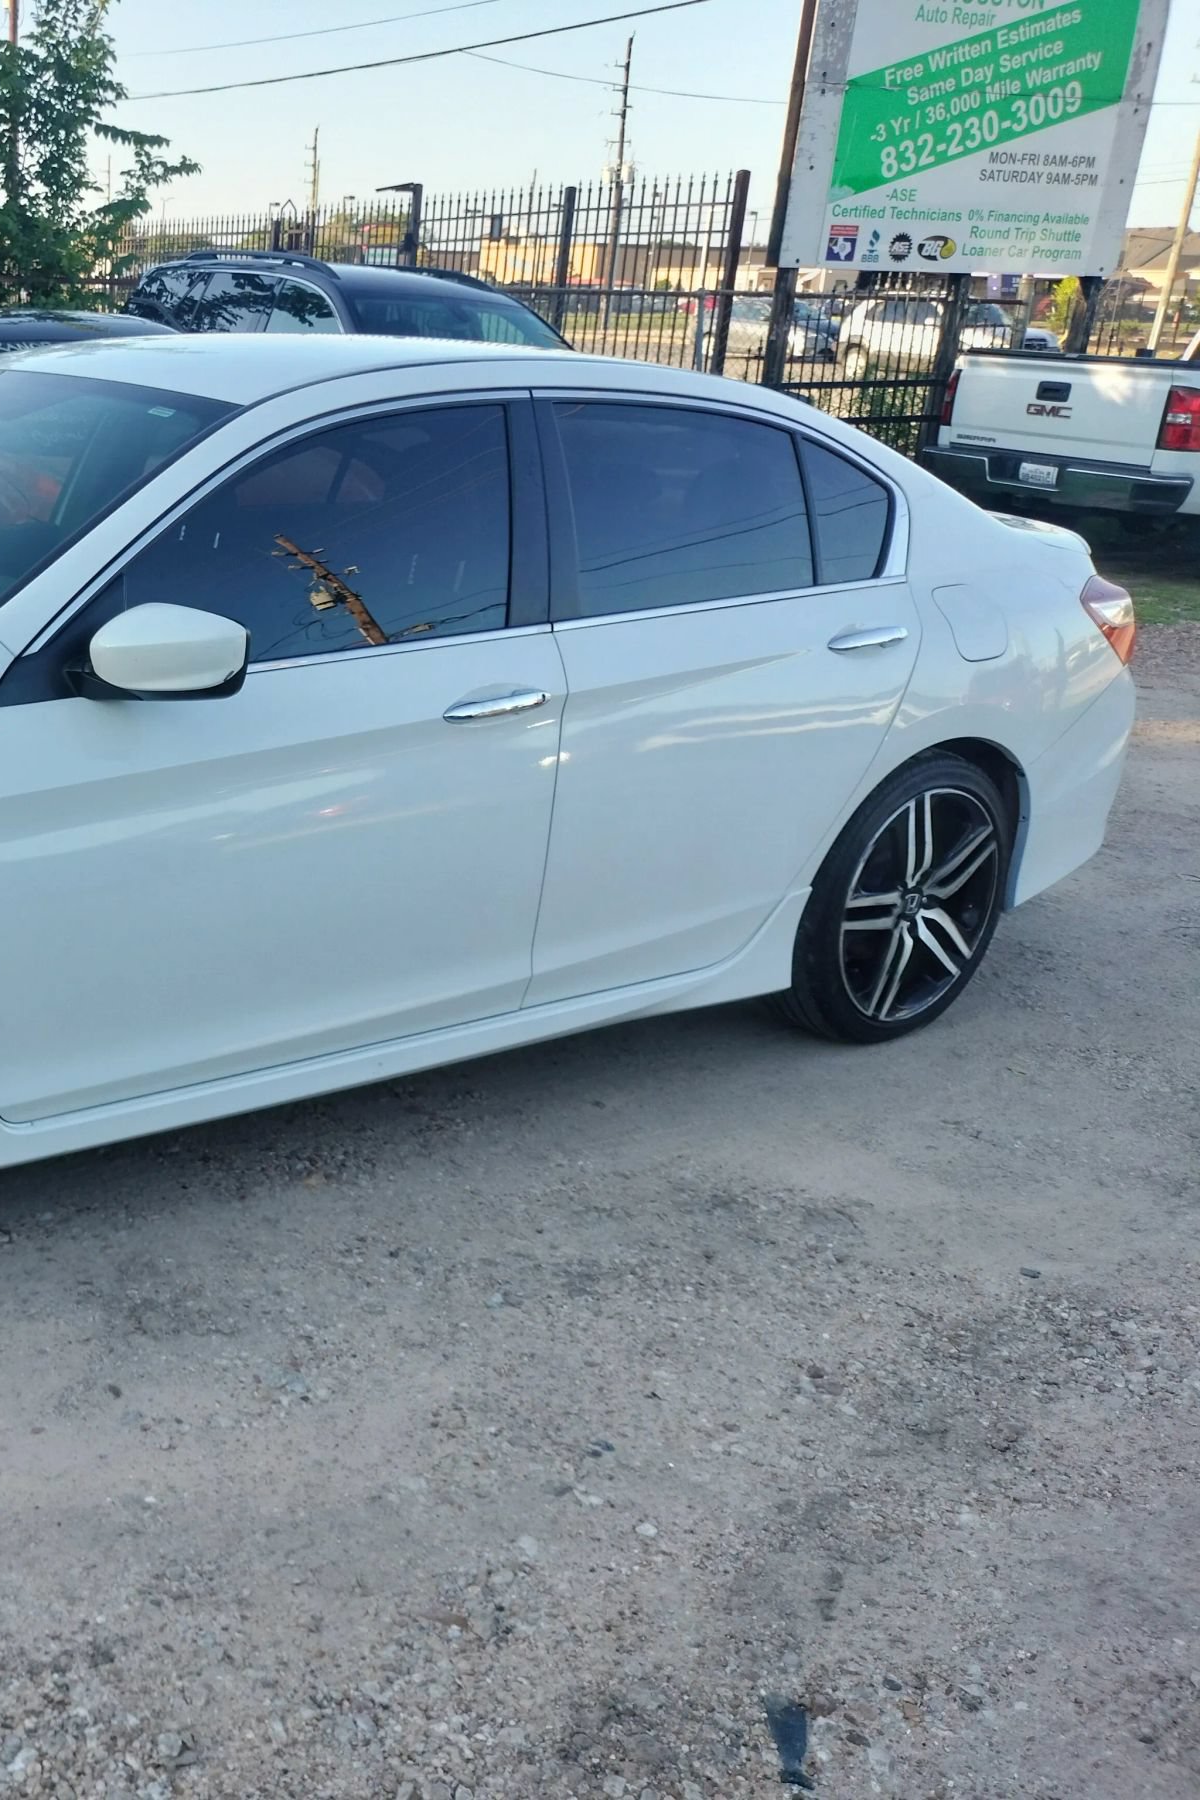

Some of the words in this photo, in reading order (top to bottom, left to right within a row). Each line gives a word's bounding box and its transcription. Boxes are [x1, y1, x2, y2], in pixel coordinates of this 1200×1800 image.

[915, 4, 948, 24] Auto
[952, 7, 997, 29] Repair
[884, 63, 924, 88] Free
[928, 38, 992, 73] Written
[997, 8, 1082, 49] Estimates
[907, 77, 956, 105] Same
[961, 63, 994, 87] Day
[1000, 40, 1064, 74] Service
[890, 117, 911, 136] Yr
[925, 90, 981, 124] 36,000
[985, 79, 1021, 104] Mile
[1026, 51, 1103, 89] Warranty
[880, 81, 1083, 179] 832-230-3009
[988, 151, 1041, 166] MON-FRI
[1042, 154, 1096, 169] 8AM-6PM
[979, 169, 1044, 184] SATURDAY
[1045, 172, 1099, 186] 9AM-5PM
[886, 188, 917, 202] -ASE
[832, 204, 886, 219] Certified
[890, 206, 962, 222] Technicians
[968, 209, 984, 221] 0%
[987, 210, 1040, 226] Financing
[1042, 212, 1090, 225] Available
[969, 226, 1010, 240] Round
[1014, 227, 1037, 243] Trip
[1040, 228, 1082, 242] Shuttle
[961, 243, 1005, 257] Loaner
[1007, 245, 1029, 258] Car
[1031, 246, 1082, 262] Program
[1026, 403, 1073, 419] GMC
